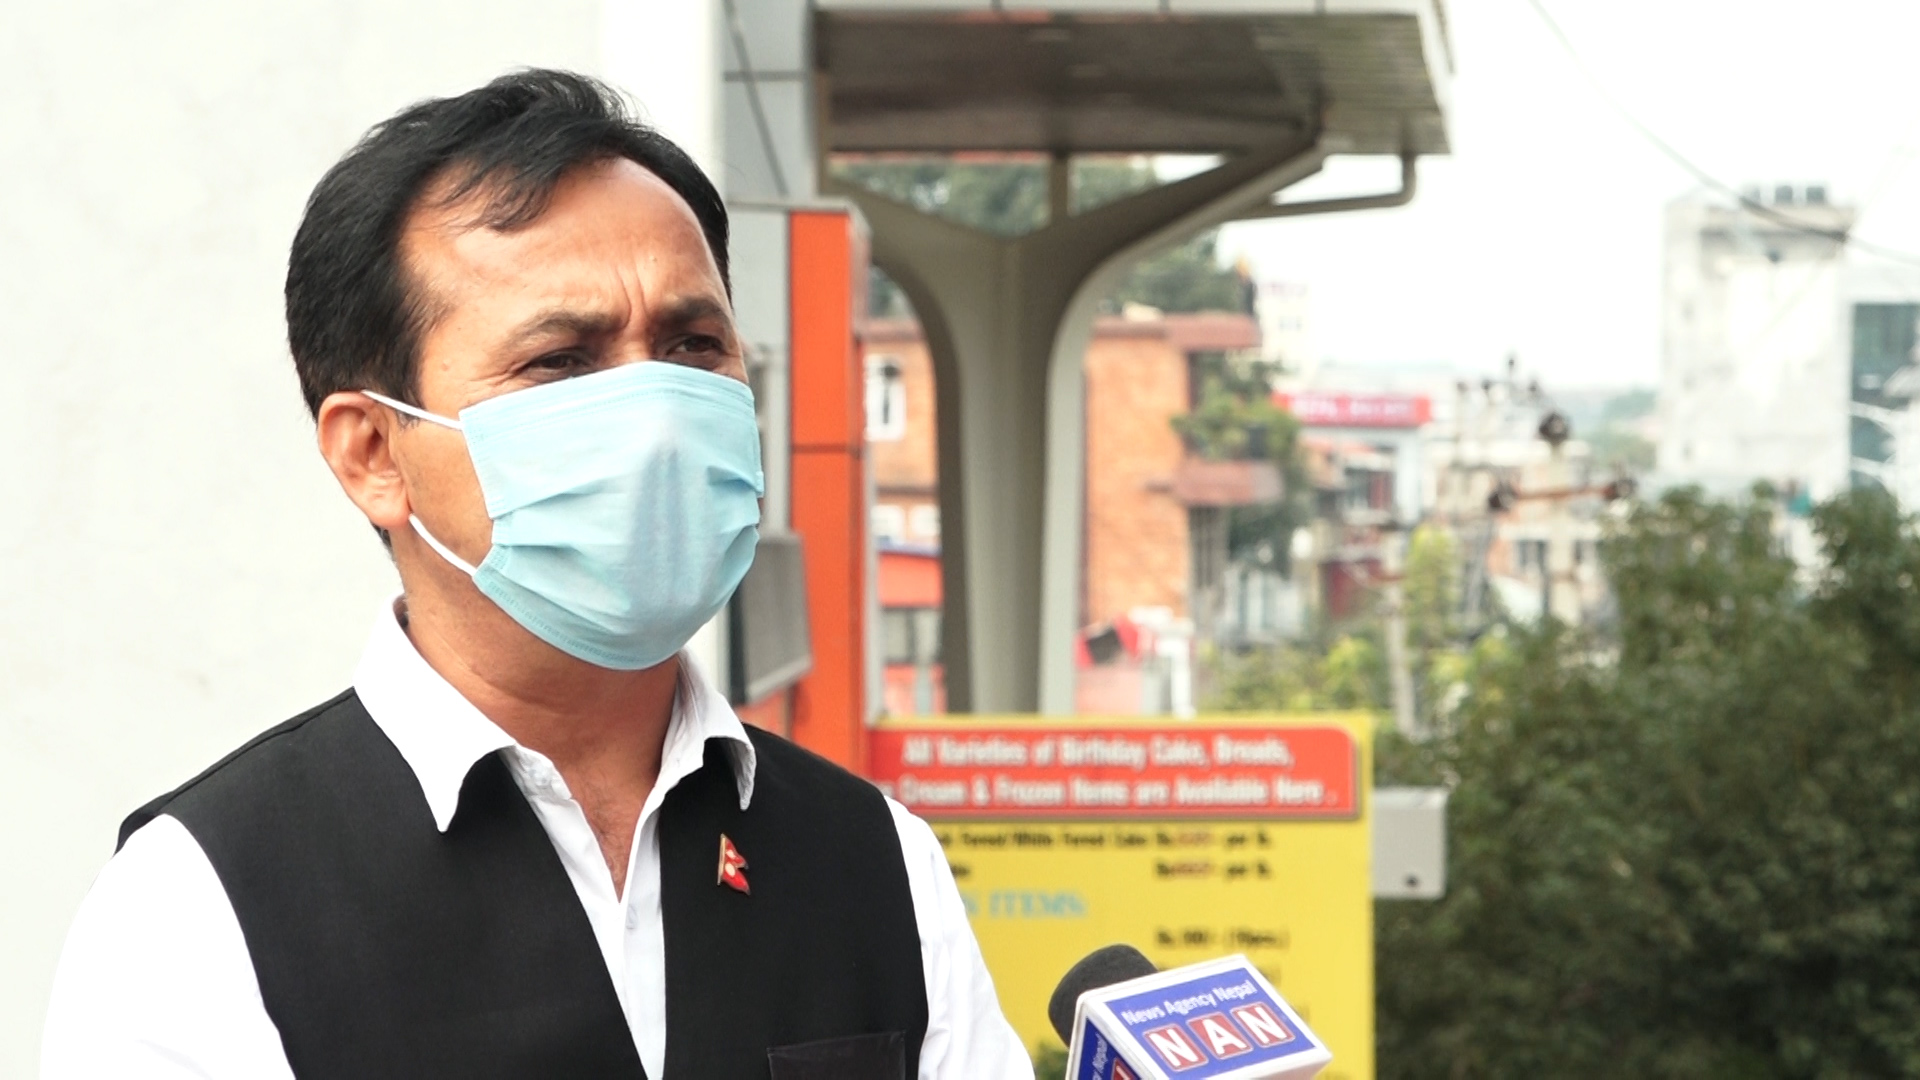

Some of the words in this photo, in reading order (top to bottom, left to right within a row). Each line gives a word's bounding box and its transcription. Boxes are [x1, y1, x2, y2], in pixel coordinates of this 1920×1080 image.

[904, 736, 932, 766] All
[938, 736, 1028, 766] Varieties
[1033, 736, 1055, 766] of
[1060, 736, 1146, 771] Birthday
[995, 776, 1065, 805] Frozen
[1072, 775, 1129, 805] Items
[1134, 782, 1169, 805] are
[1174, 775, 1269, 805] Available
[1121, 1005, 1165, 1026] News
[1162, 991, 1219, 1016] Agency
[1213, 979, 1258, 1002] Nepal
[1148, 1006, 1289, 1068] NAN
